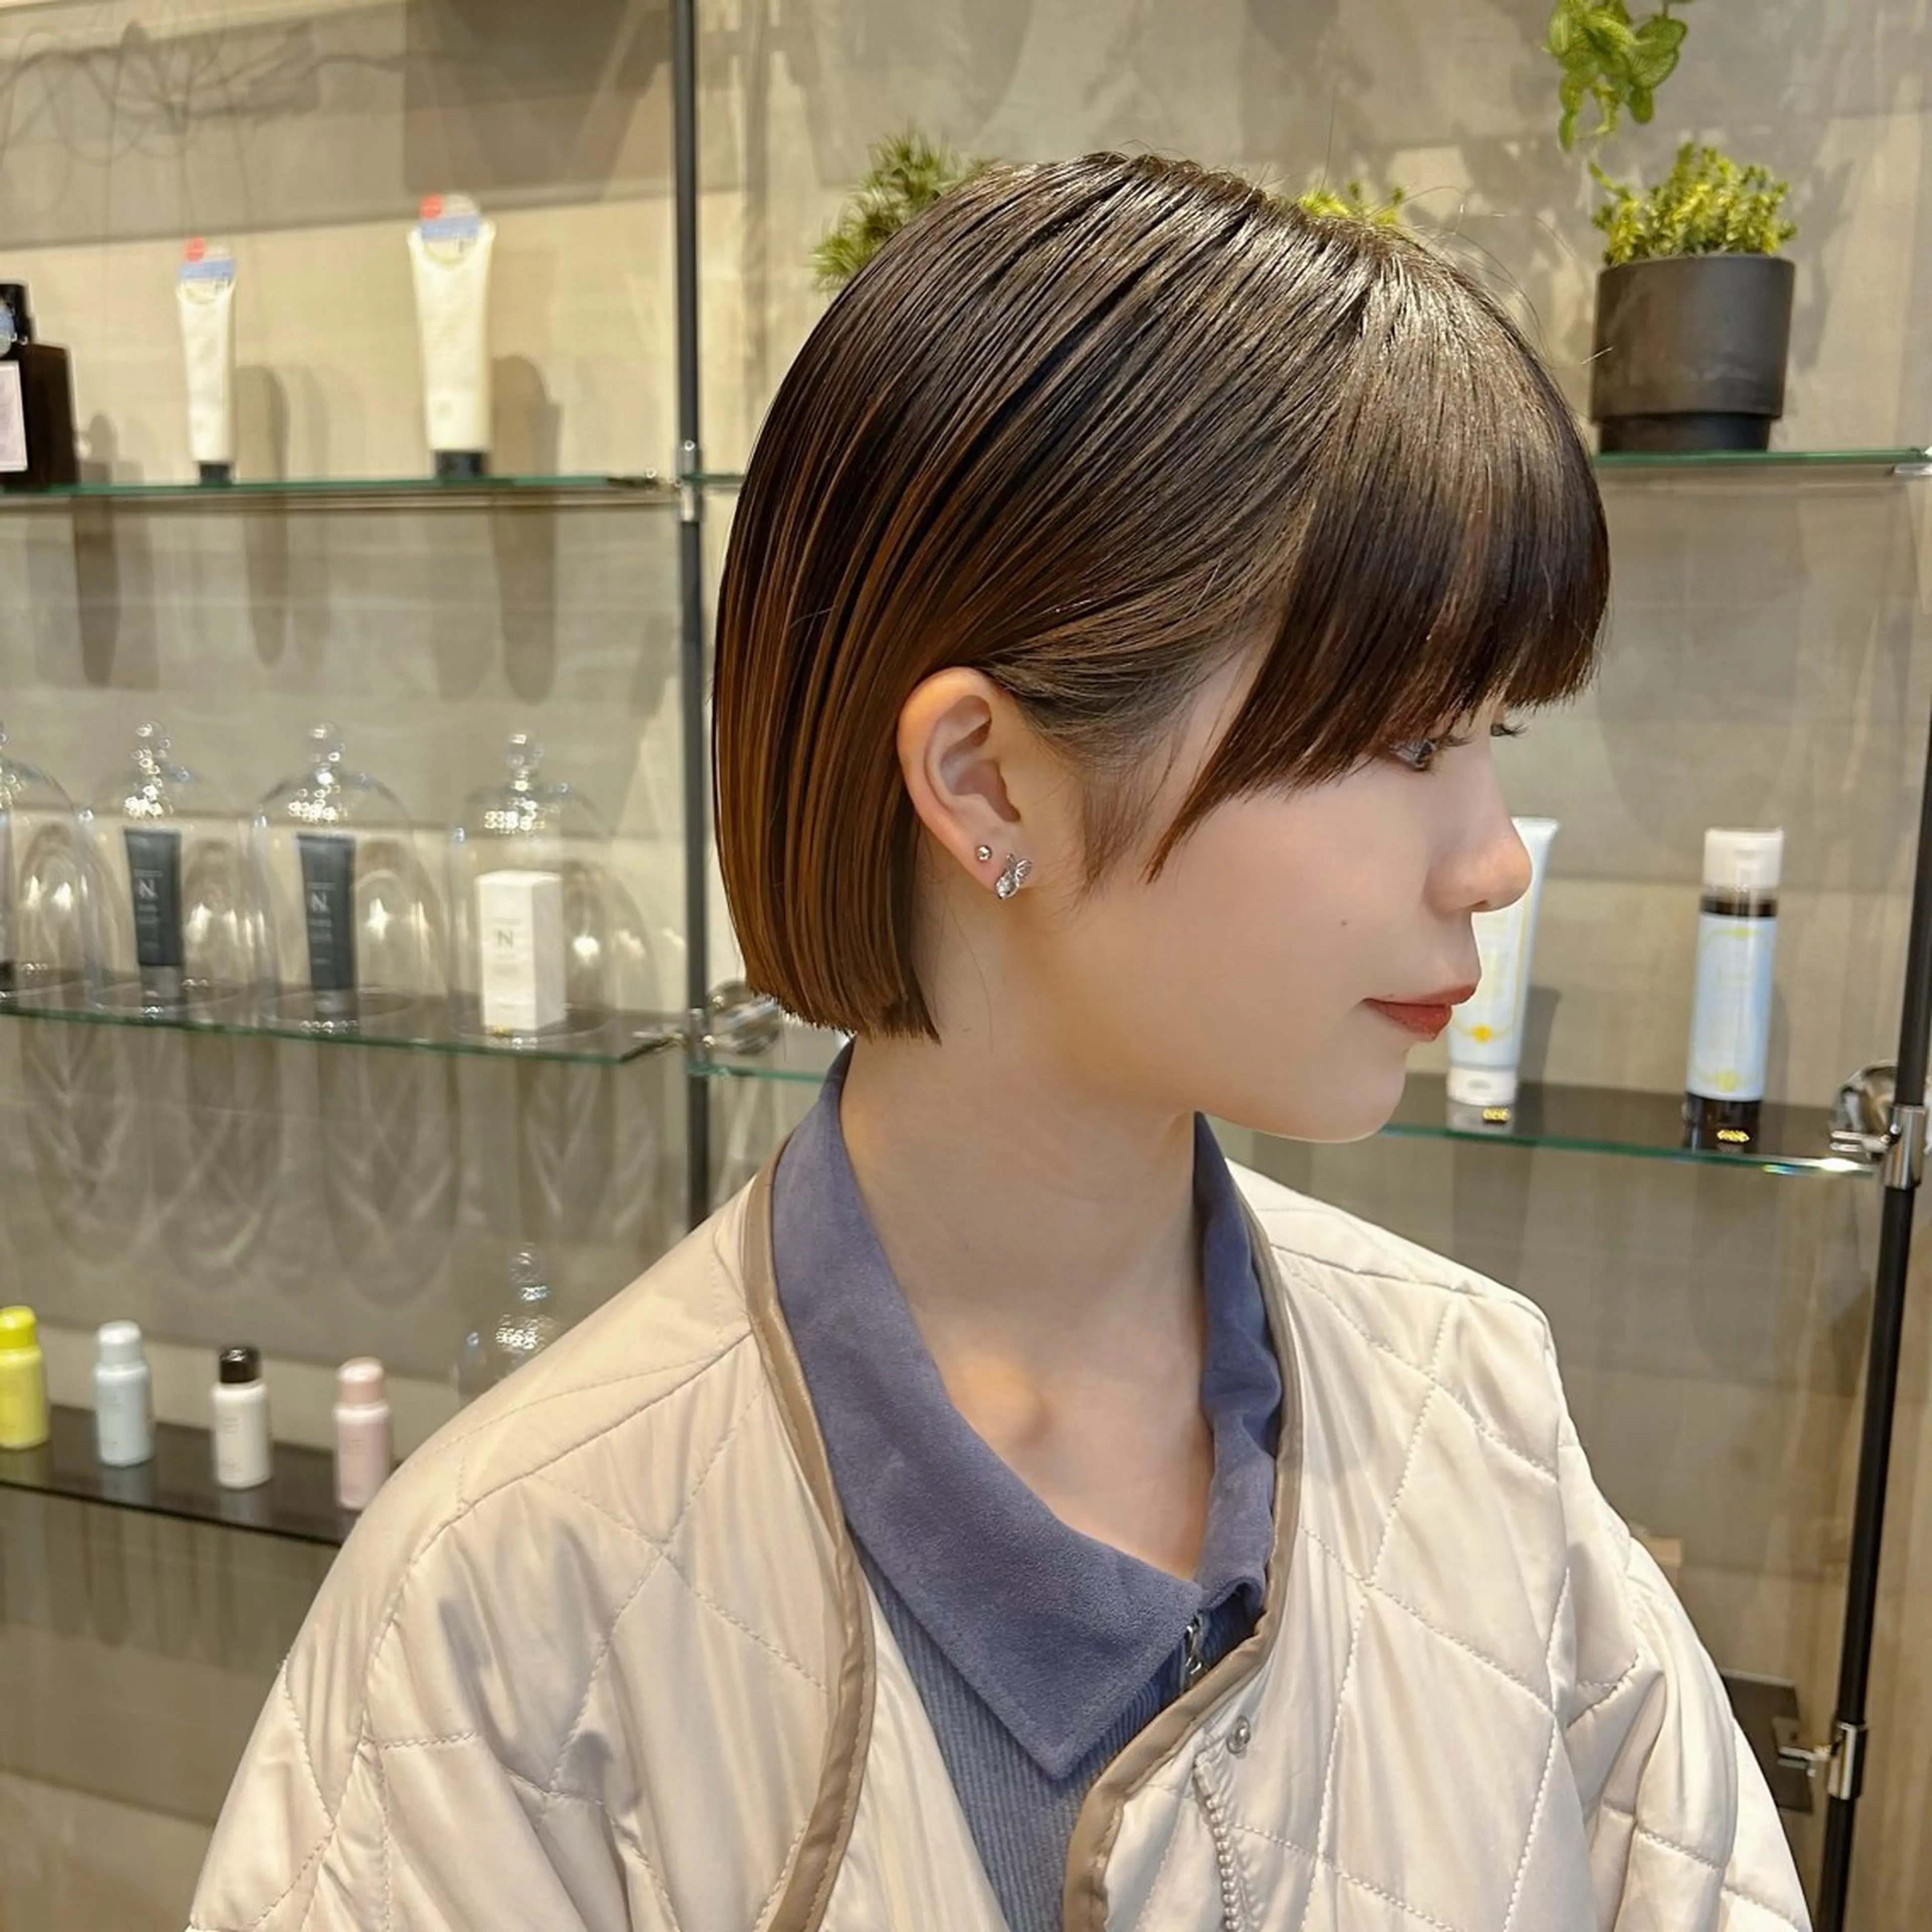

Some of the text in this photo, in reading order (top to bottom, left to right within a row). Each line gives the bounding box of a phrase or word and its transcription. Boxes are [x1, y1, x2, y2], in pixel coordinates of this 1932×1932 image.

[139, 879, 156, 899] N
[310, 892, 328, 913] N
[497, 928, 514, 949] N
